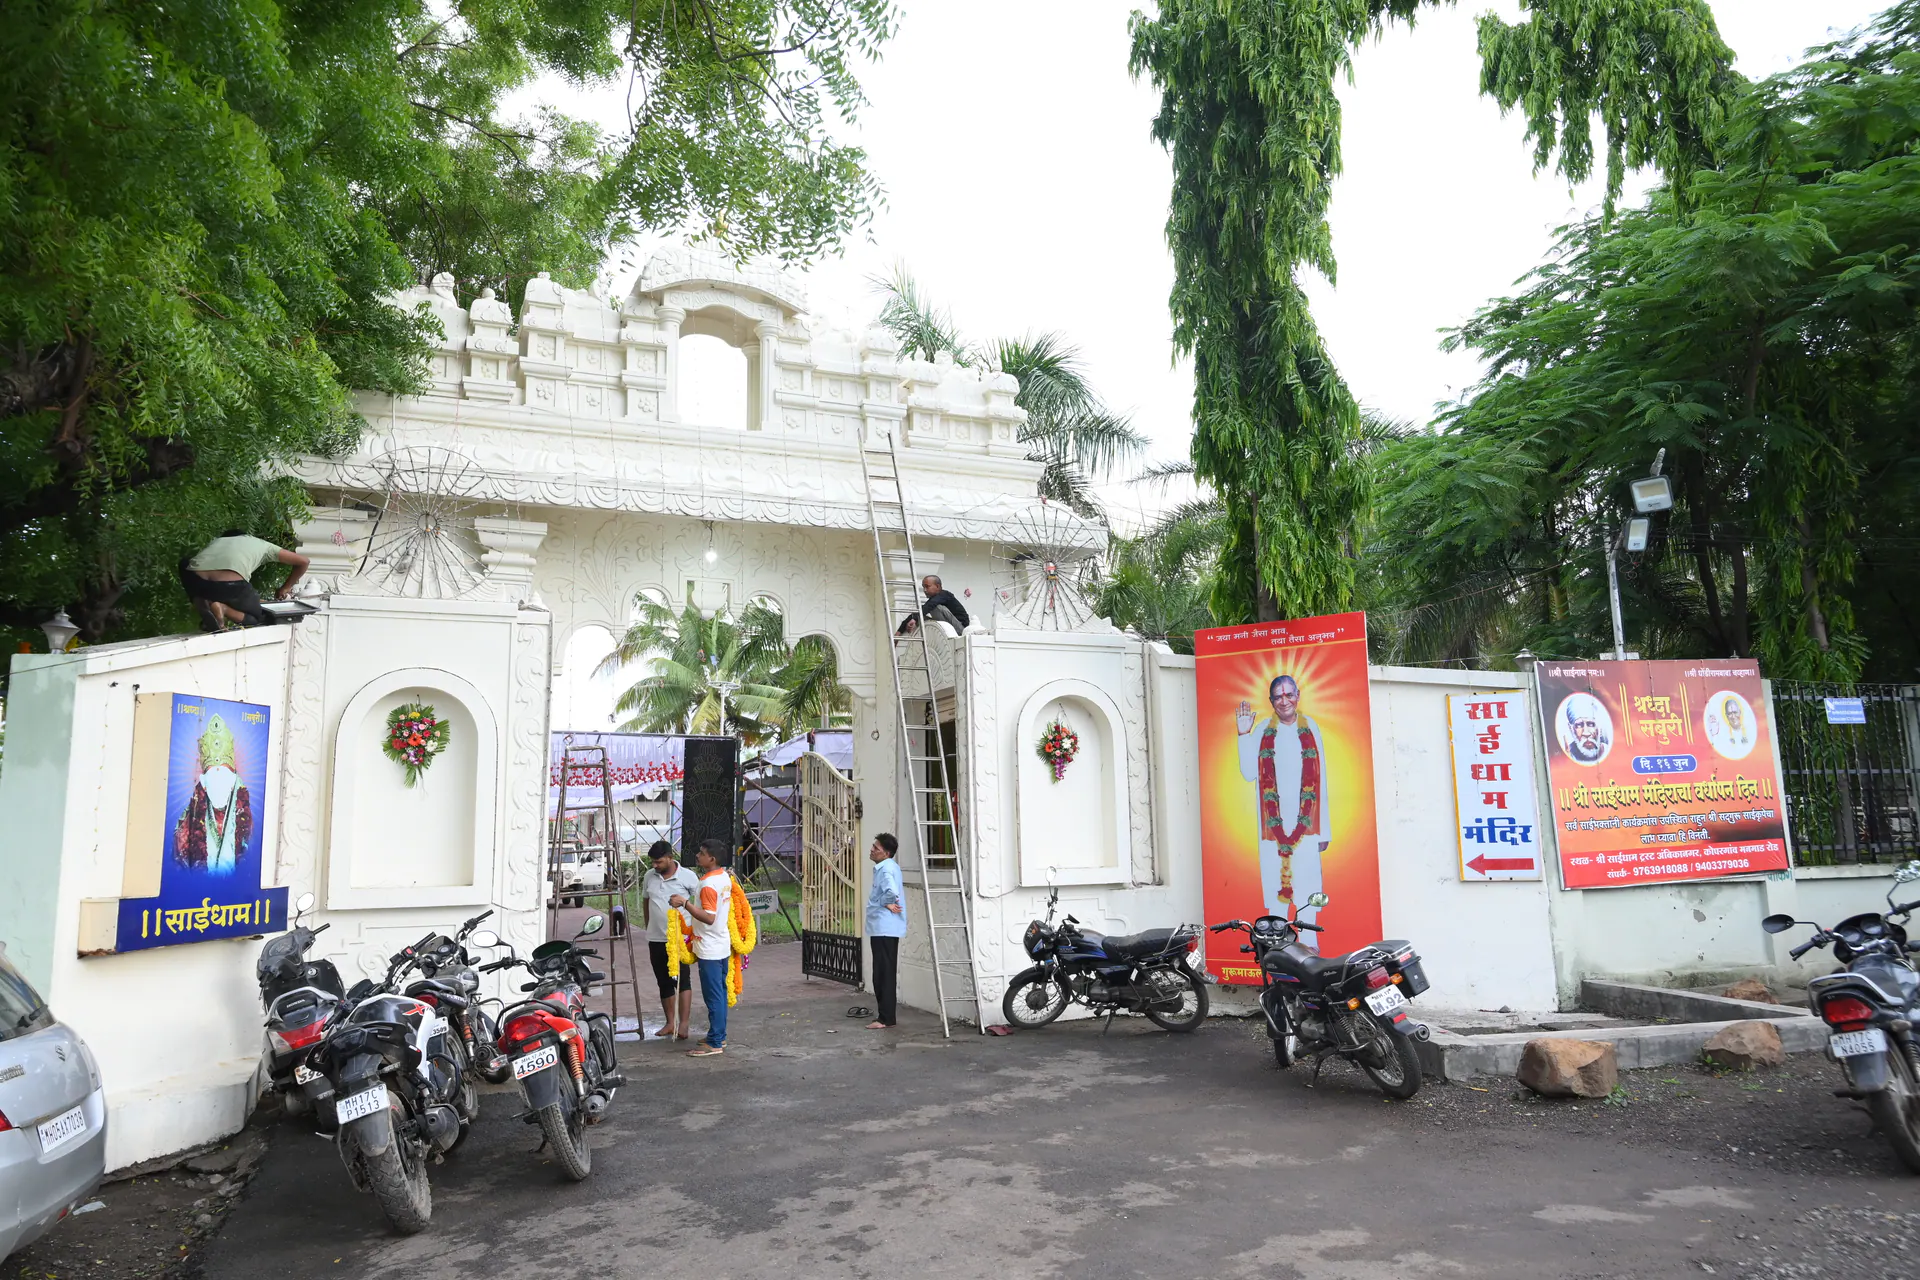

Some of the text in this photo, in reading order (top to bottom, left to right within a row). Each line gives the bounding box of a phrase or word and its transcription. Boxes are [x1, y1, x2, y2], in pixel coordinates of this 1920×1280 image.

[1638, 712, 1683, 745] सबुरी
[1672, 758, 1689, 771] जुन
[1573, 781, 1589, 808] श्री
[1591, 778, 1641, 810] साईधाम
[1642, 777, 1693, 809] मंदिराचा
[1736, 773, 1760, 804] दिन
[1462, 816, 1533, 846] मंदिर
[1565, 818, 1578, 831] सर्व
[1659, 812, 1688, 825] उपस्थित
[1708, 809, 1717, 822] श्री
[1640, 833, 1656, 844] लाभ
[1596, 852, 1605, 864] श्री
[1607, 851, 1638, 864] साईधाम
[1639, 852, 1655, 862] ट्रस्ट
[1739, 843, 1765, 854] मनमाड
[1766, 841, 1779, 852] रोड
[1633, 863, 1688, 877] 9763918088
[1695, 858, 1750, 872] 9403379036
[516, 1053, 556, 1075] 4590
[344, 1089, 378, 1110] MH17C
[346, 1099, 380, 1120] P1513
[44, 1110, 84, 1146] MH05AX7038
